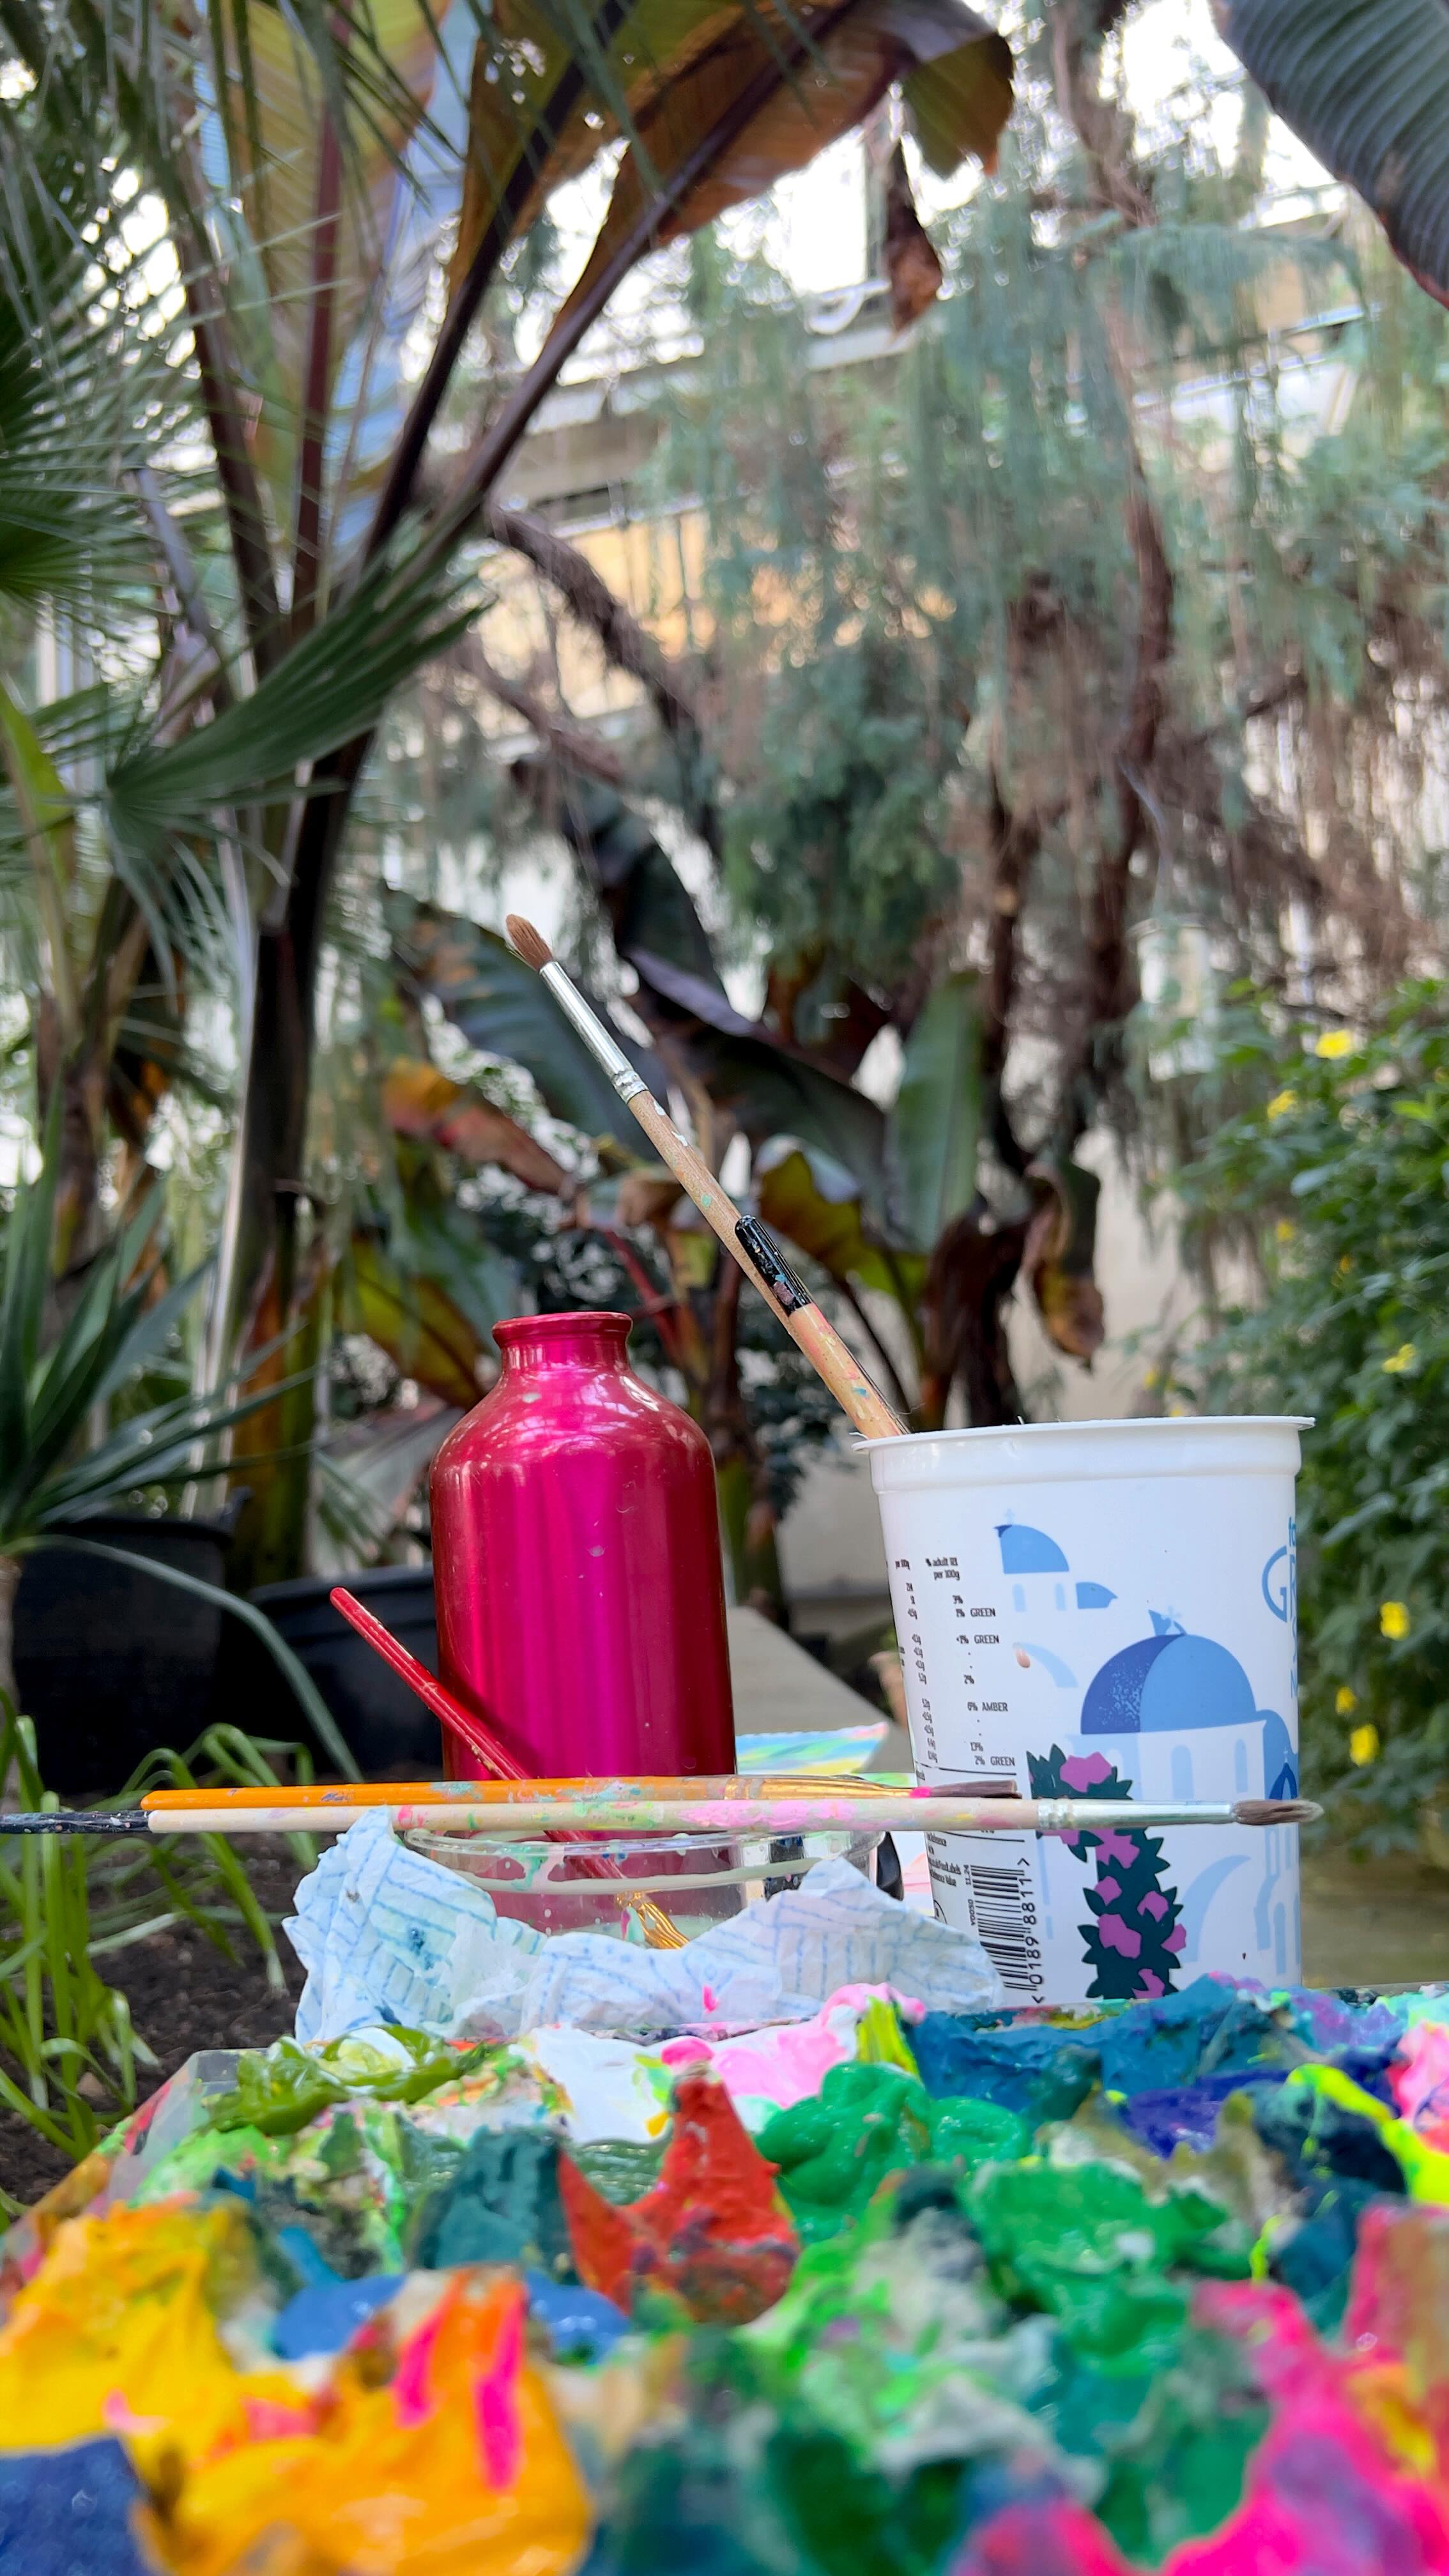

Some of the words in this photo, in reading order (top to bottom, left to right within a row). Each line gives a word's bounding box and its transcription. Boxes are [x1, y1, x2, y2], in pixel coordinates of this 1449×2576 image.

[932, 1557, 948, 1567] adult
[933, 1571, 943, 1581] per
[944, 1569, 960, 1581] 100g
[970, 1607, 996, 1618] GREEN
[974, 1634, 1000, 1644] GREEN
[963, 1674, 975, 1685] 2%
[982, 1701, 1009, 1712] AMBER
[974, 1755, 986, 1765] 2%
[990, 1756, 1016, 1767] GREEN
